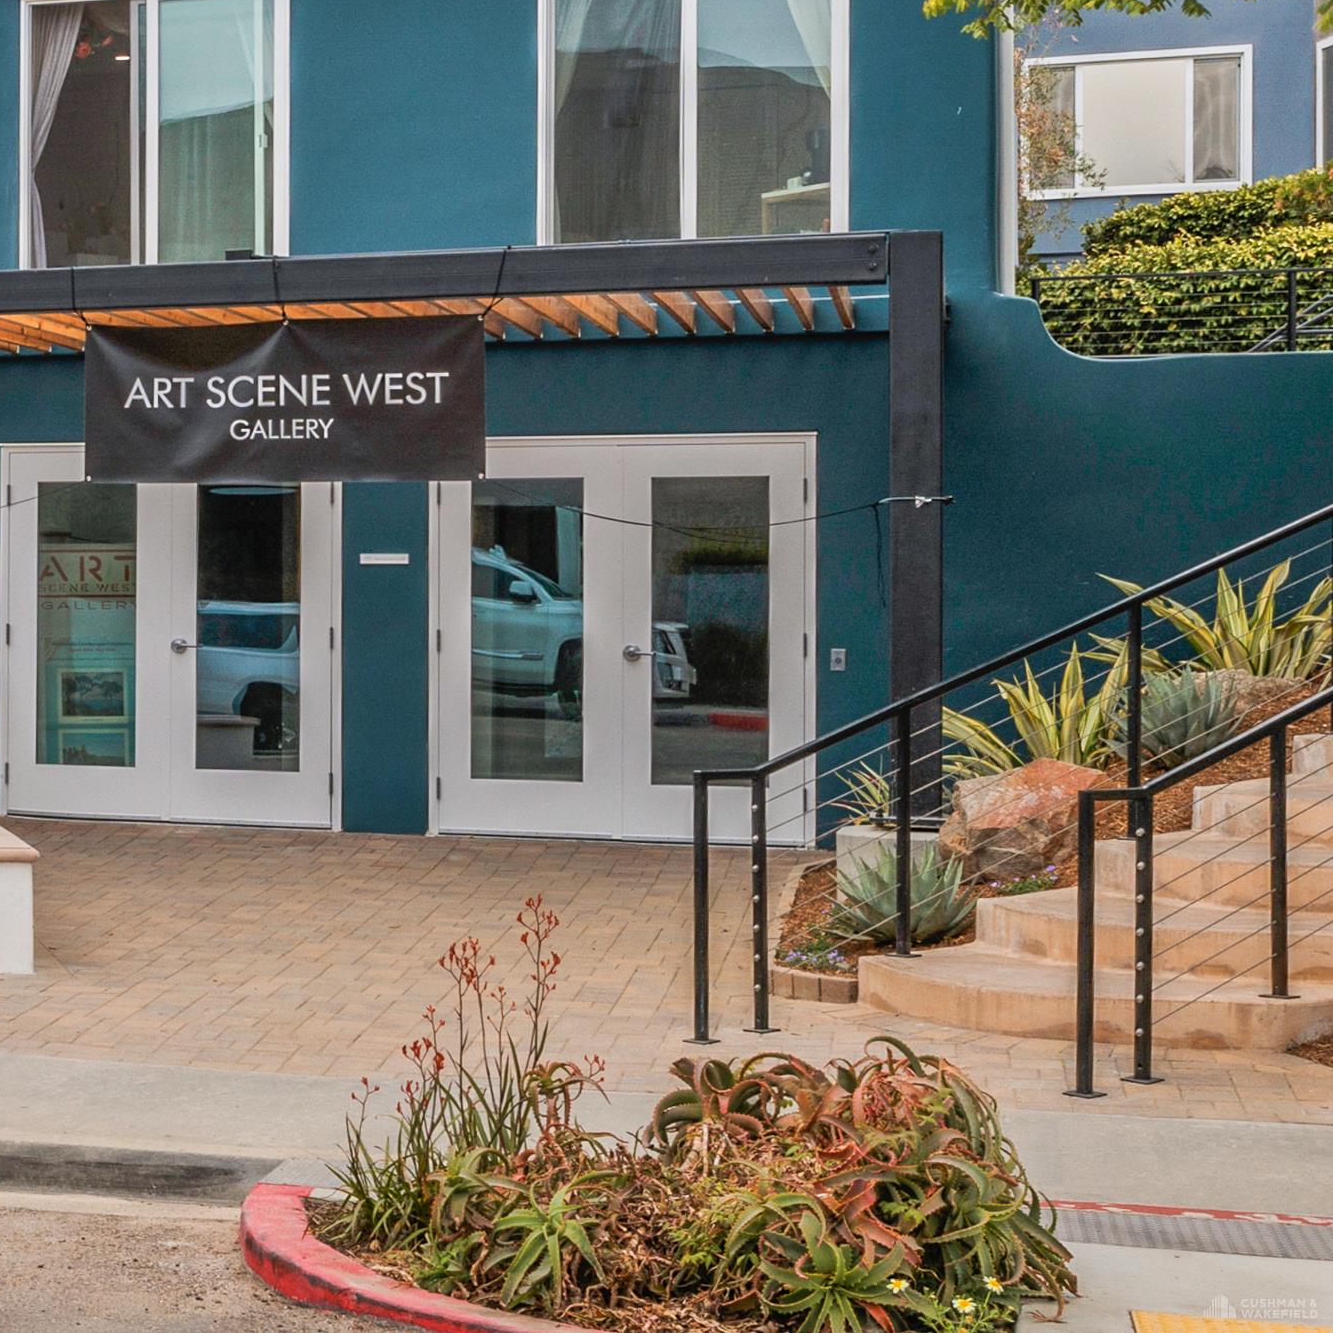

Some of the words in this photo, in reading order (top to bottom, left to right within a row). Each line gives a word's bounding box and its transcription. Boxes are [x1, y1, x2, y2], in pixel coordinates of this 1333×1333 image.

[123, 376, 195, 409] ART
[205, 373, 331, 409] SCENE
[341, 371, 450, 406] WEST
[229, 417, 335, 441] GALLERY
[38, 555, 137, 582] ART
[38, 582, 90, 593] SCENE
[96, 582, 137, 593] WES
